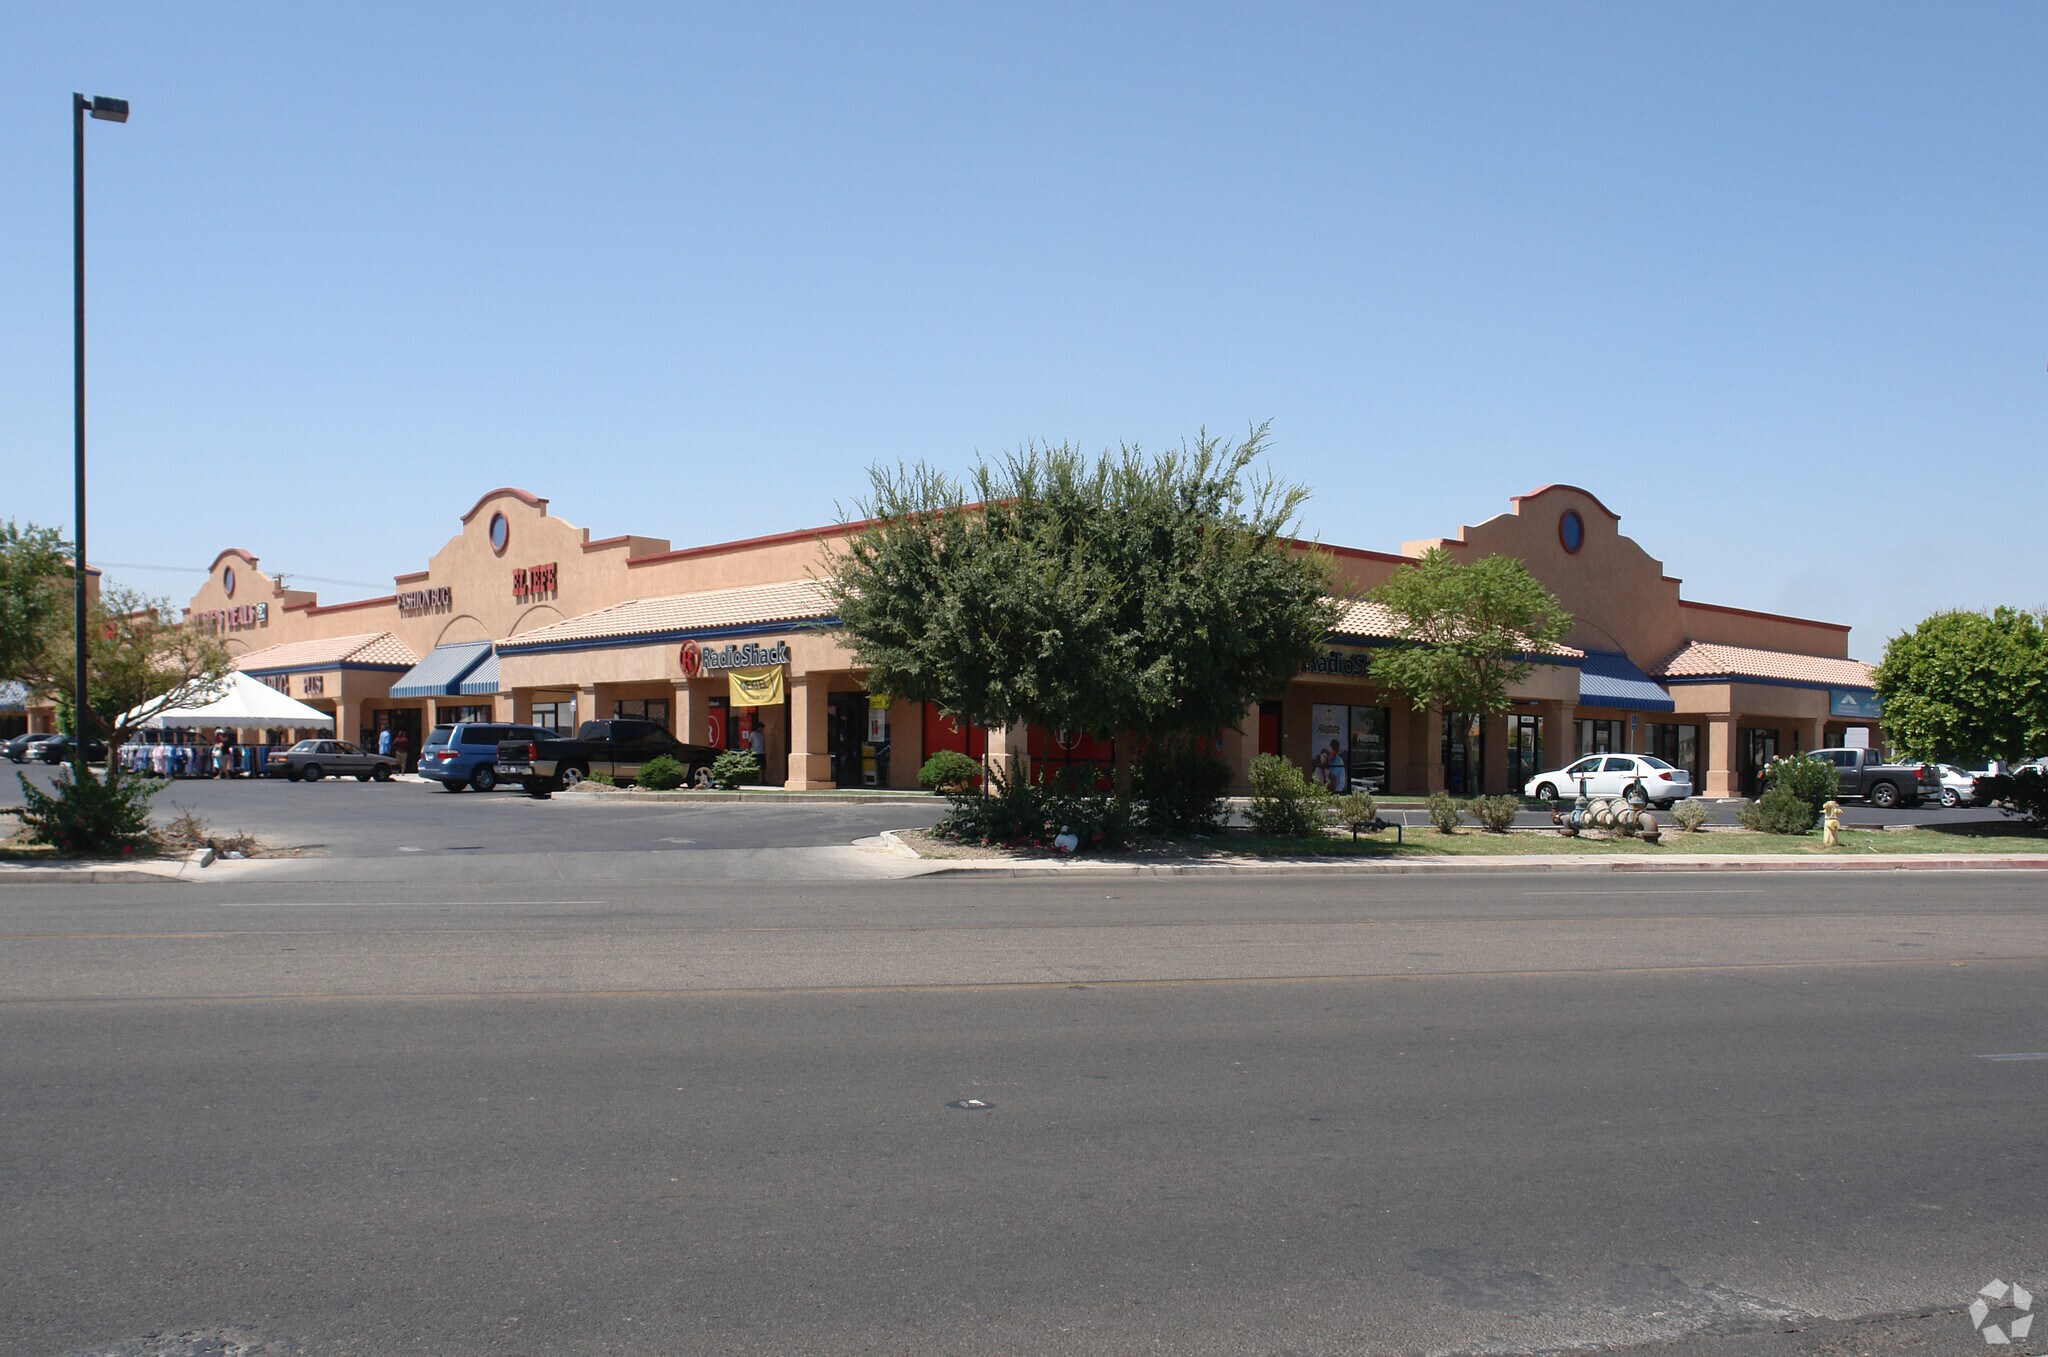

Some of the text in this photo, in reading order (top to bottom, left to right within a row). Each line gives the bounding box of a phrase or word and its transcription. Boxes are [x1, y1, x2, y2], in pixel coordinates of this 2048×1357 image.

[512, 562, 556, 597] EL JEFE
[398, 586, 450, 610] FASHION BUG
[226, 605, 256, 626] DEALS
[701, 640, 788, 669] RadioShack
[303, 675, 323, 694] PLUS
[1316, 723, 1341, 735] Allstate
[1356, 733, 1380, 743] Allstate
